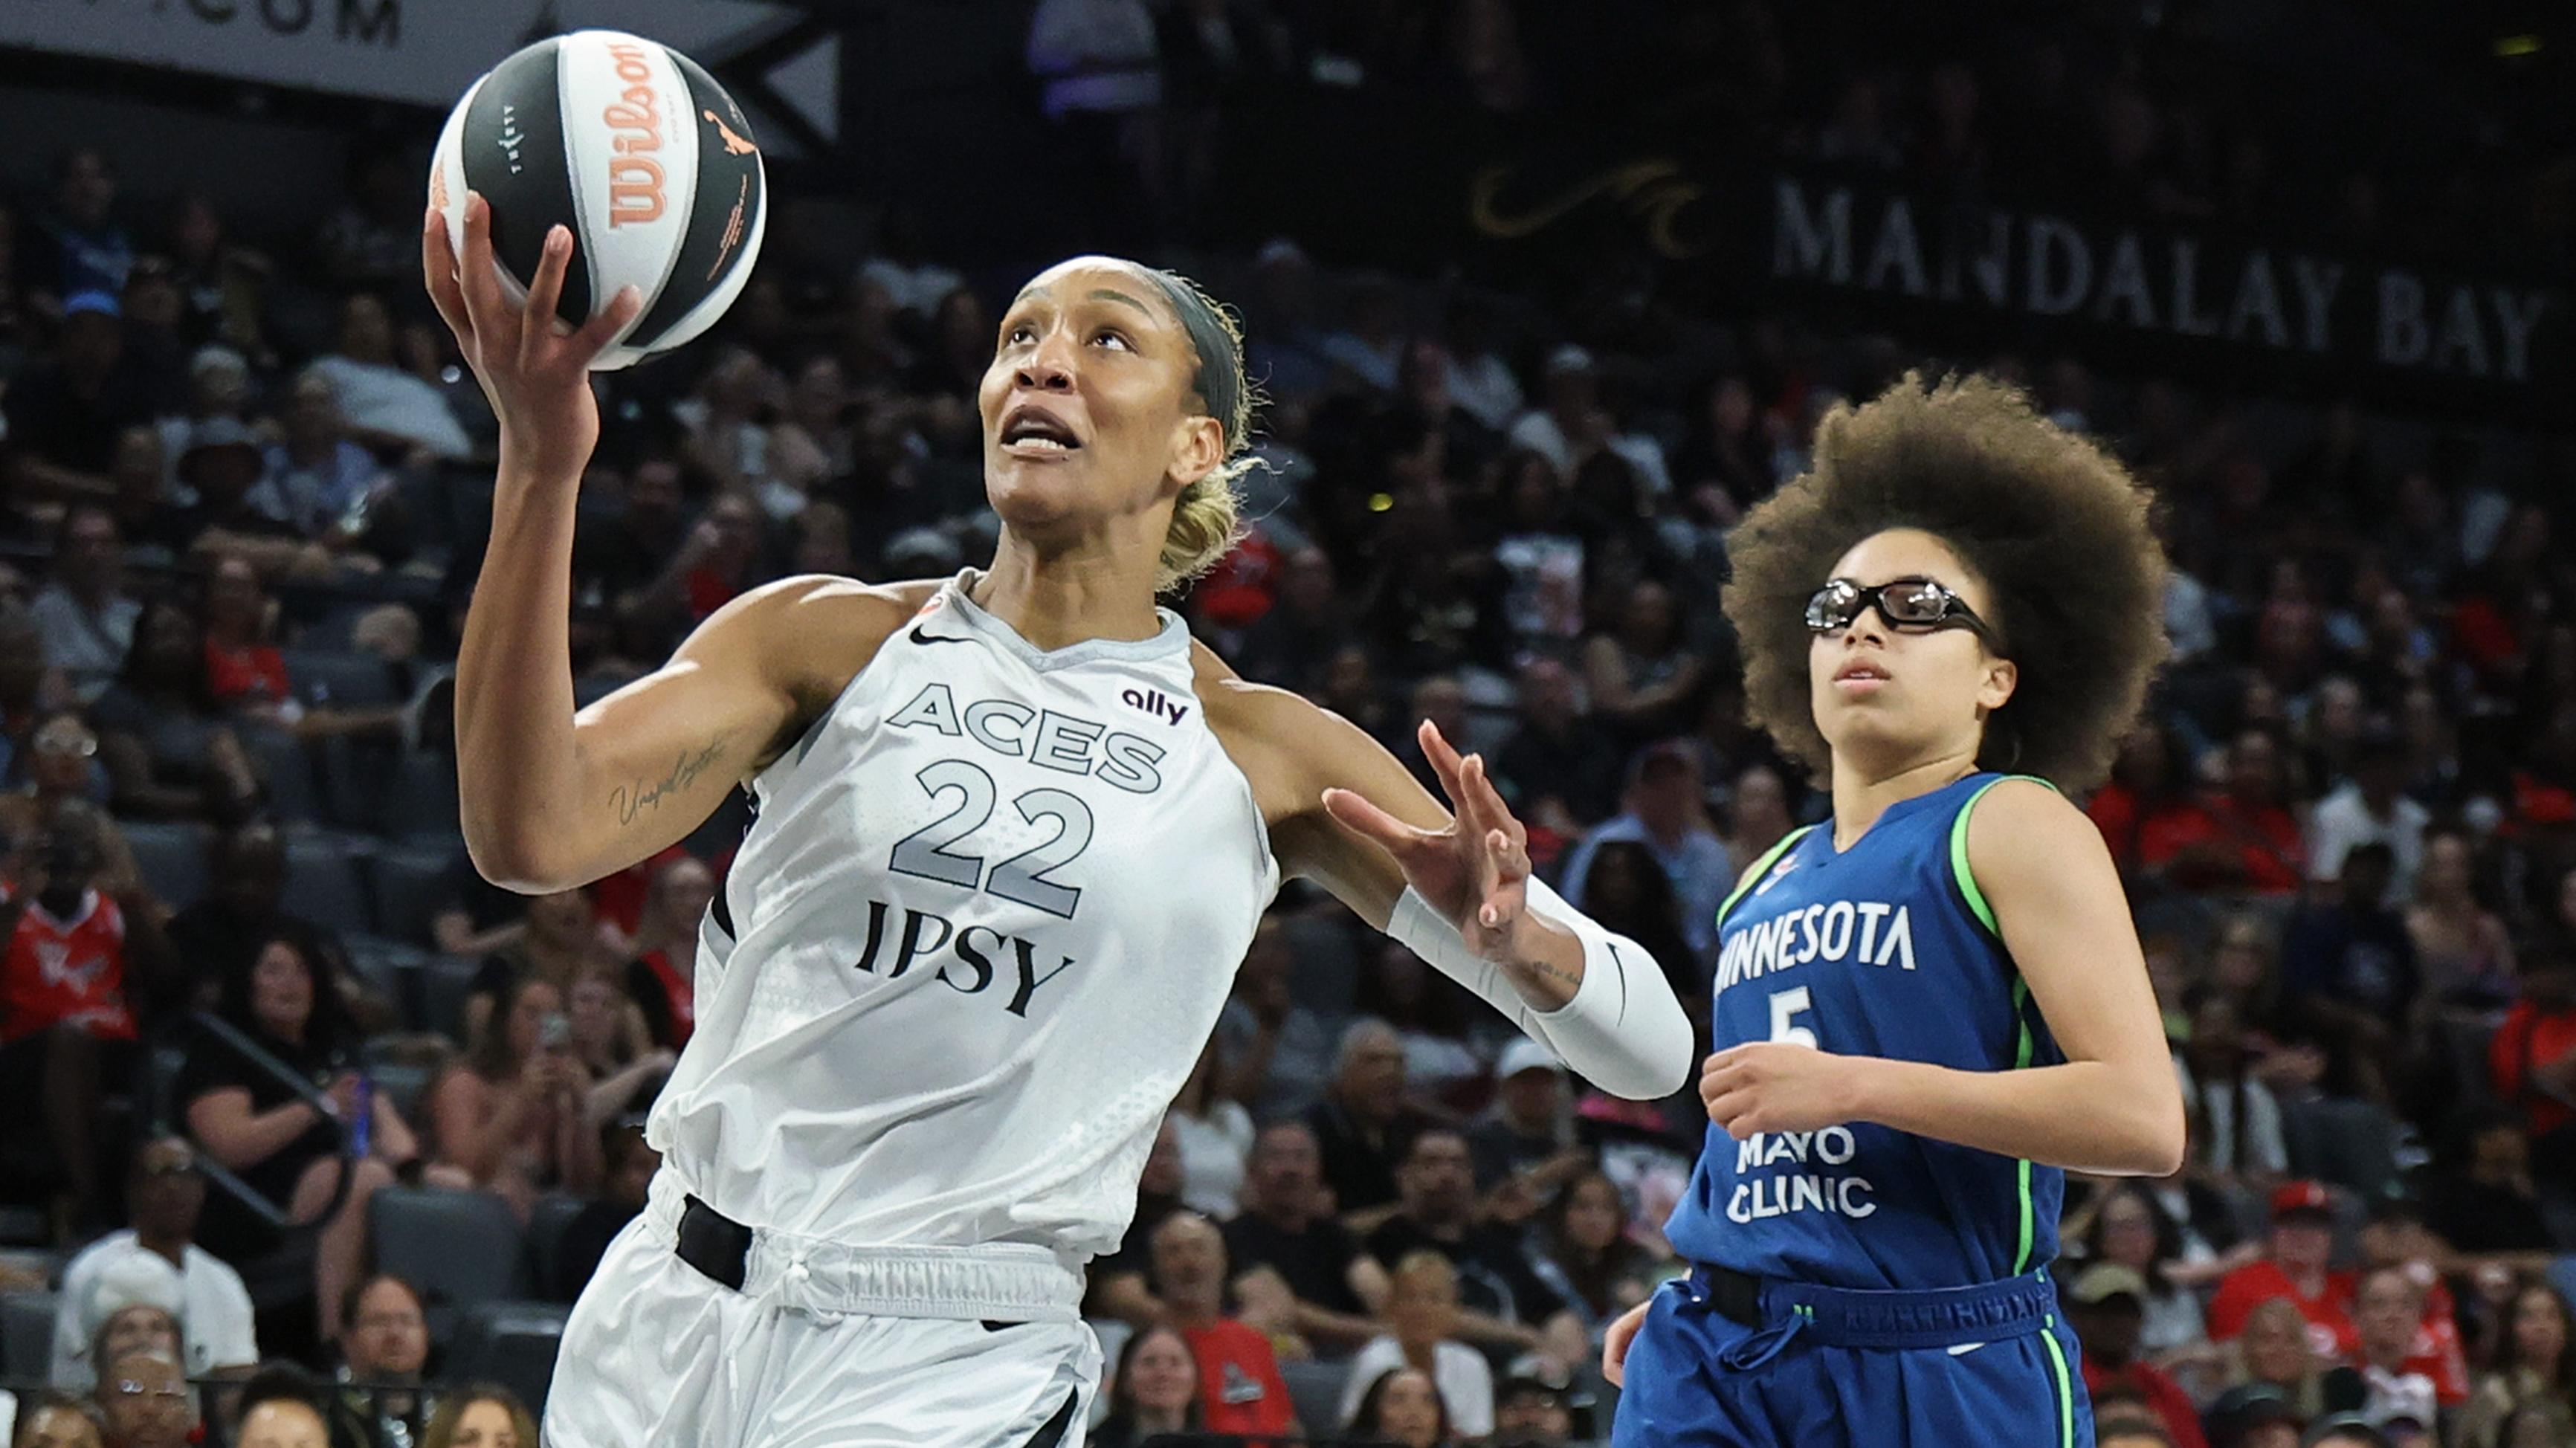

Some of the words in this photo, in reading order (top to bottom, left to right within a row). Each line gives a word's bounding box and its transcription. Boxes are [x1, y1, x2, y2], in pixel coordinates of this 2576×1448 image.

[601, 40, 668, 230] Wilson
[1772, 174, 2345, 353] MANDALAY
[2374, 265, 2548, 384] BAY
[885, 682, 1168, 795] ACES
[1121, 688, 1189, 727] ally
[888, 758, 1095, 921] 22
[853, 899, 1076, 1018] IPSY
[1726, 1174, 1878, 1224] CLINIC
[1735, 1125, 1856, 1174] MAYO
